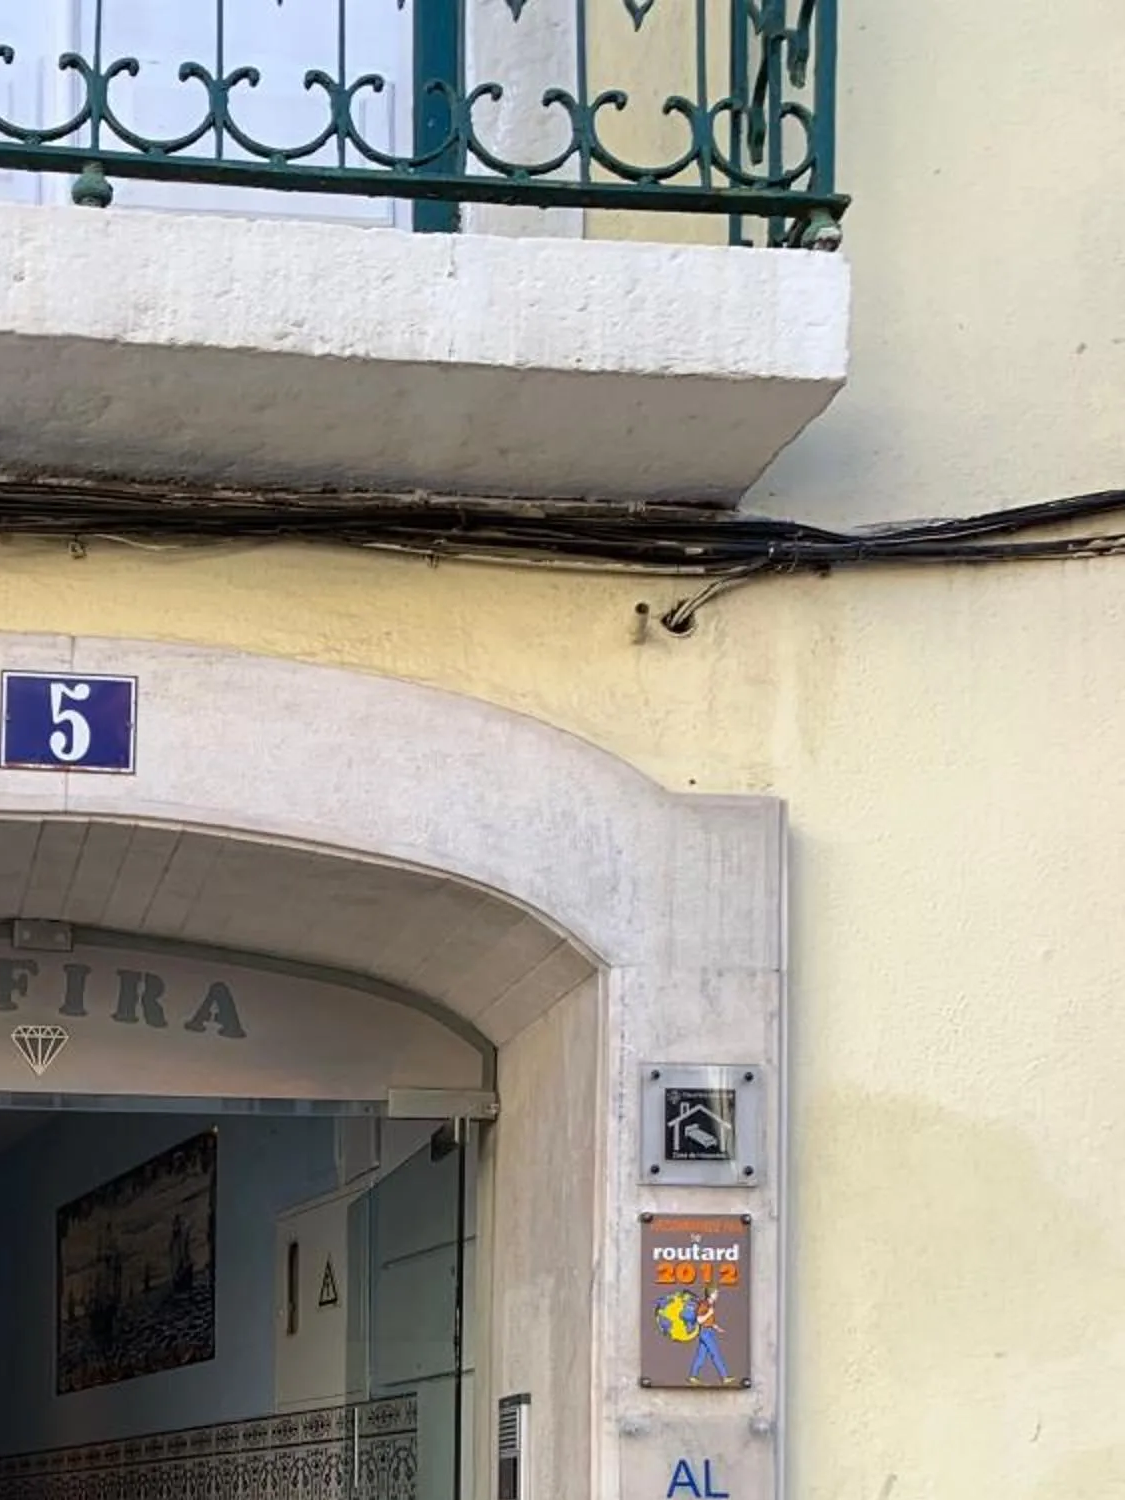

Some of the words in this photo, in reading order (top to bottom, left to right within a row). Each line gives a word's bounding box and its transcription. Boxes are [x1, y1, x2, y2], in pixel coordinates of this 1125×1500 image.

[48, 682, 92, 762] 5
[652, 1243, 740, 1261] routard
[654, 1261, 740, 1286] 2012
[666, 1457, 730, 1499] AL
